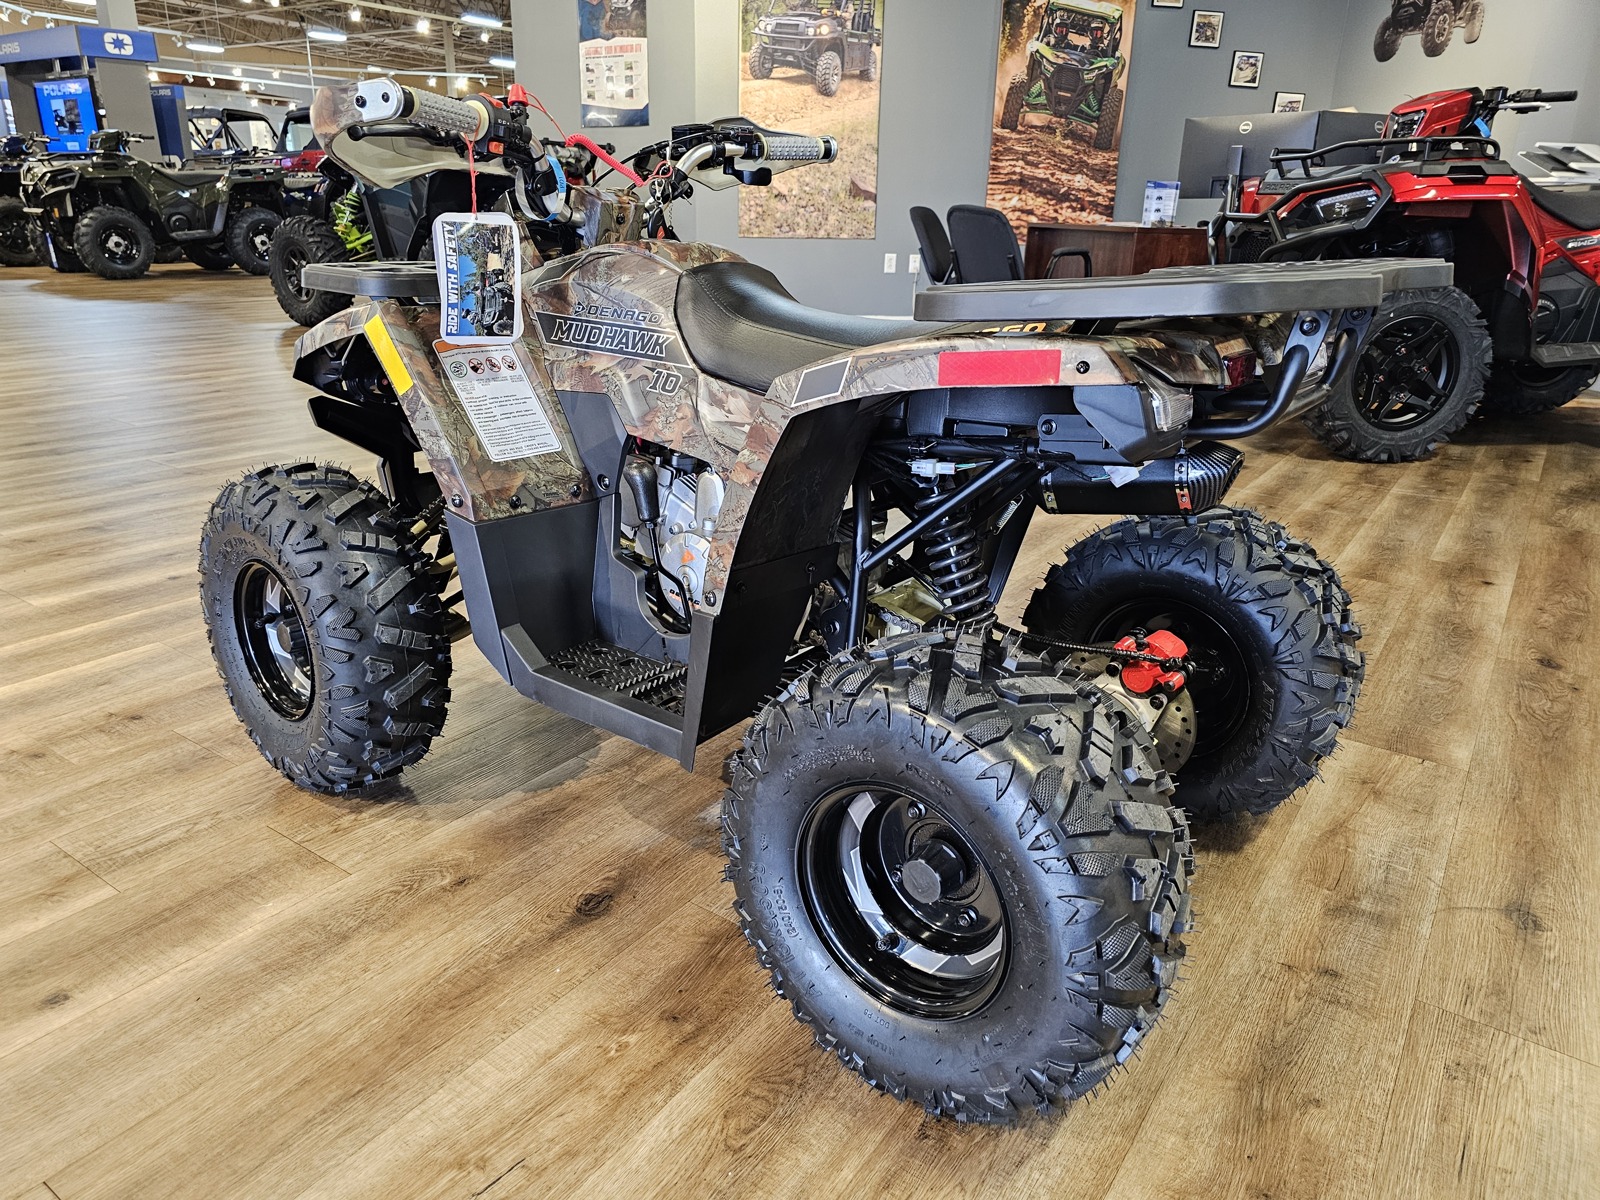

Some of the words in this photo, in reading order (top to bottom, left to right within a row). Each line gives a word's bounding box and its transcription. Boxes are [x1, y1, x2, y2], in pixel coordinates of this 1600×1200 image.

[43, 83, 82, 97] POLARIS
[443, 222, 458, 271] SAFETY
[447, 275, 459, 304] WITH
[447, 307, 458, 334] RIDE
[588, 304, 664, 325] DENAGO
[551, 319, 676, 358] MUDHAWK
[647, 368, 683, 396] 10
